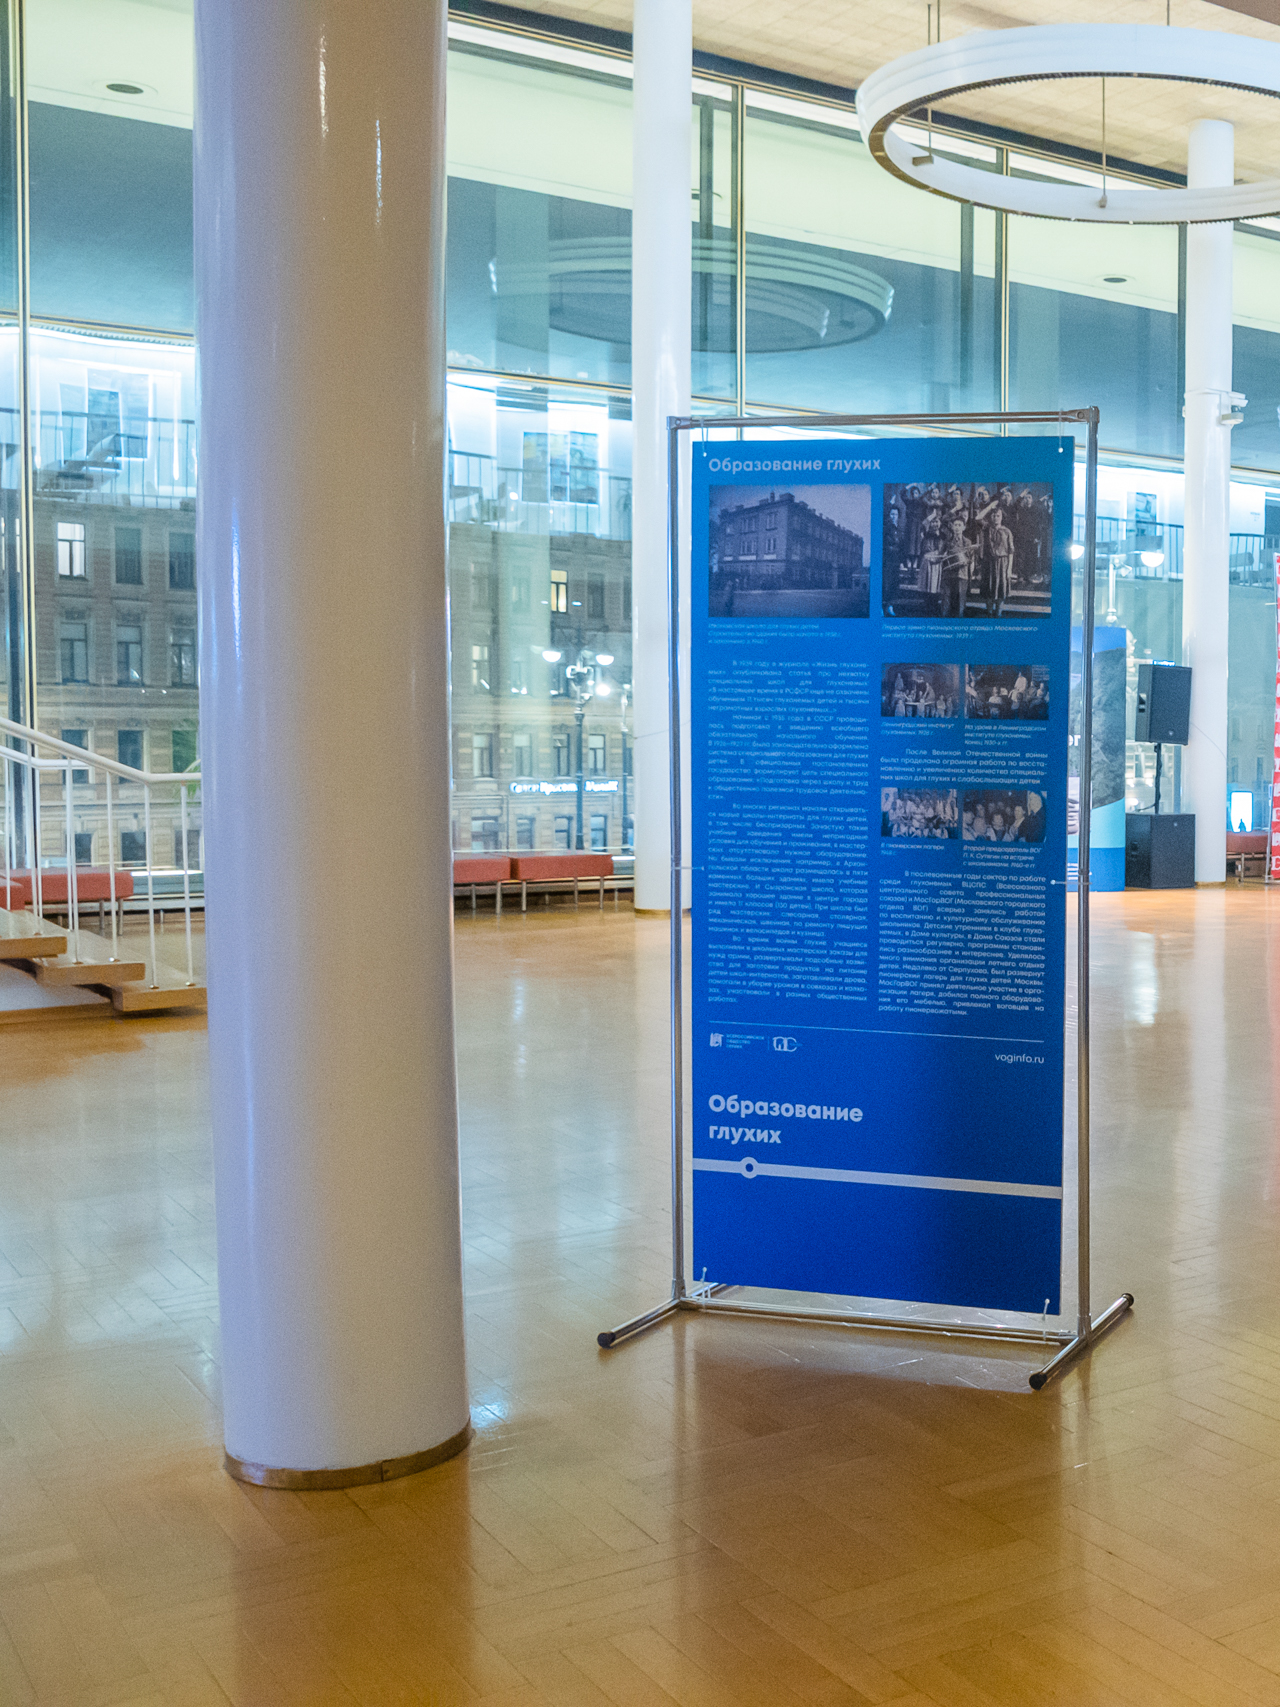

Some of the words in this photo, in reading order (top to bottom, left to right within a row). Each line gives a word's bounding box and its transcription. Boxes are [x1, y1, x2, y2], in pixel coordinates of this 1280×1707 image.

[708, 457, 822, 475] Образование
[827, 459, 880, 473] глухих
[994, 1053, 1044, 1064] voginfo.ru
[708, 1094, 863, 1122] Образование
[709, 1125, 781, 1145] глухих
